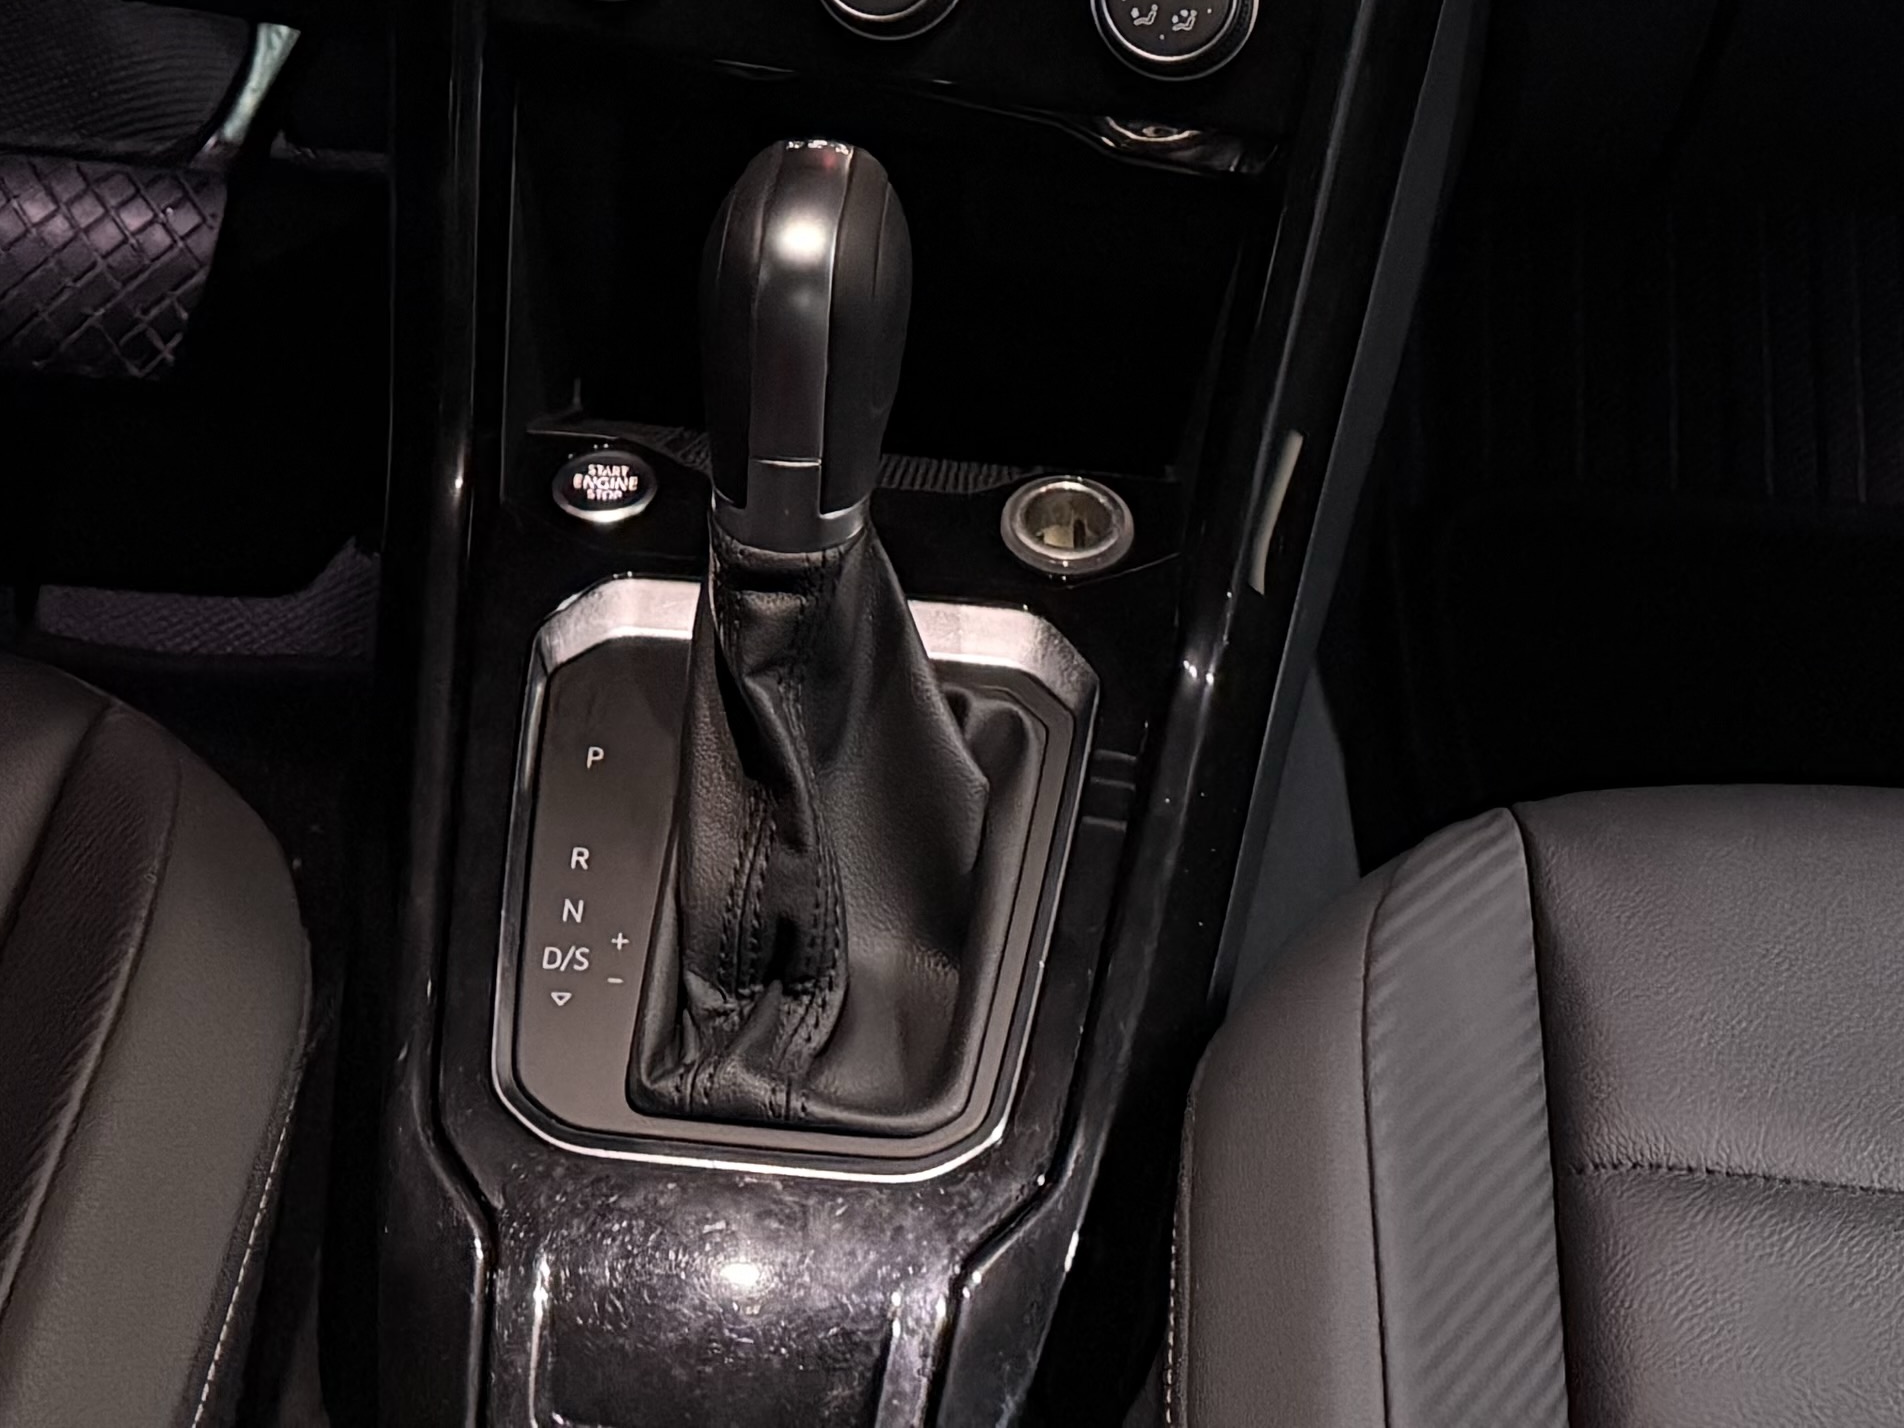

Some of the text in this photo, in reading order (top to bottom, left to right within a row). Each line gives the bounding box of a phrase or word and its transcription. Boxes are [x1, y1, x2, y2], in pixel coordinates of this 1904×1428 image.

[588, 463, 630, 476] START
[573, 472, 639, 492] ENGINE
[587, 488, 623, 501] STOP
[586, 746, 605, 769] P
[570, 846, 590, 870] R
[562, 898, 584, 923] N
[542, 945, 590, 971] D/S
